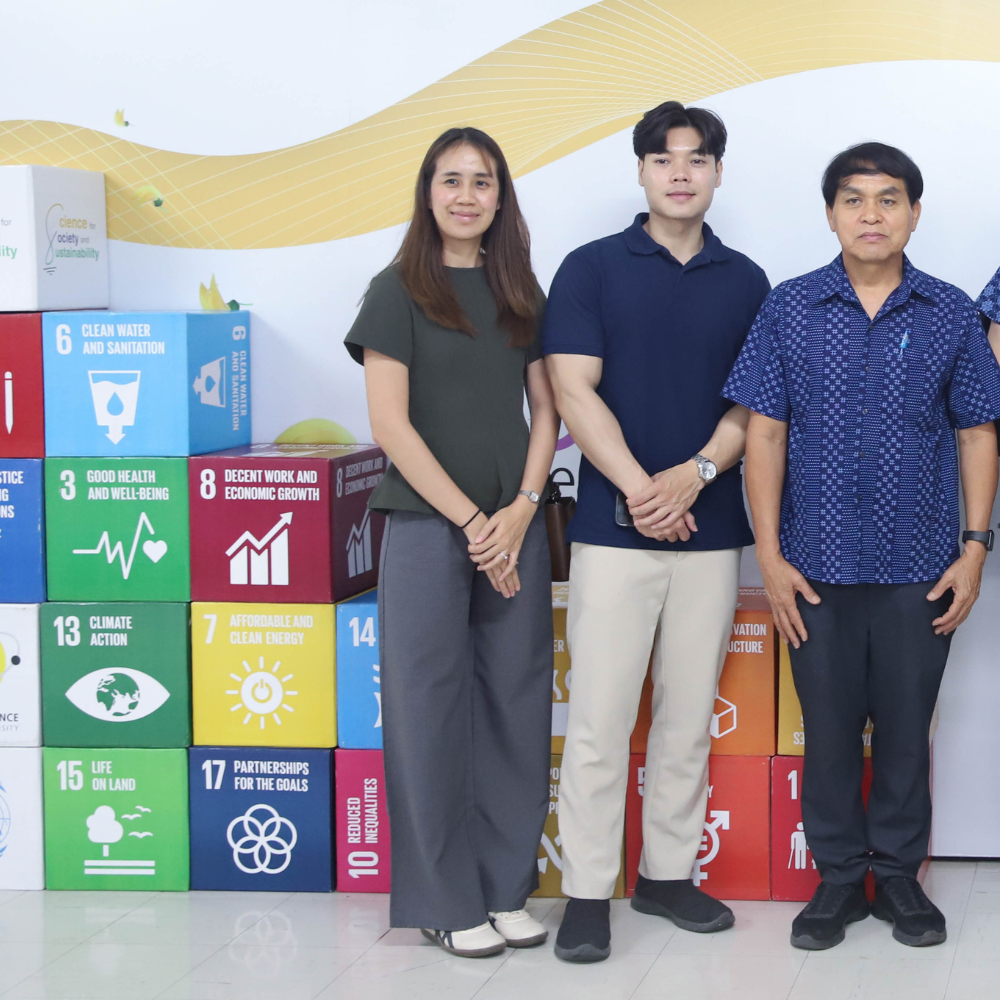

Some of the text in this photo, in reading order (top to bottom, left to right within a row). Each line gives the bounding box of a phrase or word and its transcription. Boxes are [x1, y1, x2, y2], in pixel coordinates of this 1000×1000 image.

[82, 324, 151, 338] CLEAN WATER
[232, 325, 247, 341] 6
[56, 324, 73, 355] 6
[83, 341, 165, 355] AND SANITATION
[232, 375, 240, 431] SANITATION
[240, 383, 248, 417] WATER
[87, 470, 156, 483] GOOD HEALTH
[225, 469, 318, 484] DECENT WORK AND
[336, 467, 344, 499] 8
[60, 469, 76, 501] 3
[200, 469, 217, 500] 8
[88, 487, 169, 500] AND WELL-BEING
[225, 486, 320, 501] ECONOMIC GROWTH
[90, 616, 133, 630] CLIMATE
[203, 614, 218, 644] 7
[230, 615, 314, 628] AFFORDABLE AND
[53, 615, 81, 647] 13
[349, 617, 376, 647] 14
[731, 623, 767, 636] VATION
[90, 633, 128, 646] ACTION
[230, 632, 304, 645] CLEAN ENERGY
[91, 761, 113, 774] LIFE
[201, 759, 227, 790] 17
[233, 761, 309, 775] PARTNERSHIPS
[56, 760, 84, 791] 15
[92, 778, 136, 791] ON LAND
[234, 777, 308, 792] FOR THE GOALS
[364, 778, 378, 844] INEQUALITIES
[347, 797, 361, 844] REDUCED
[348, 851, 379, 878] 10
